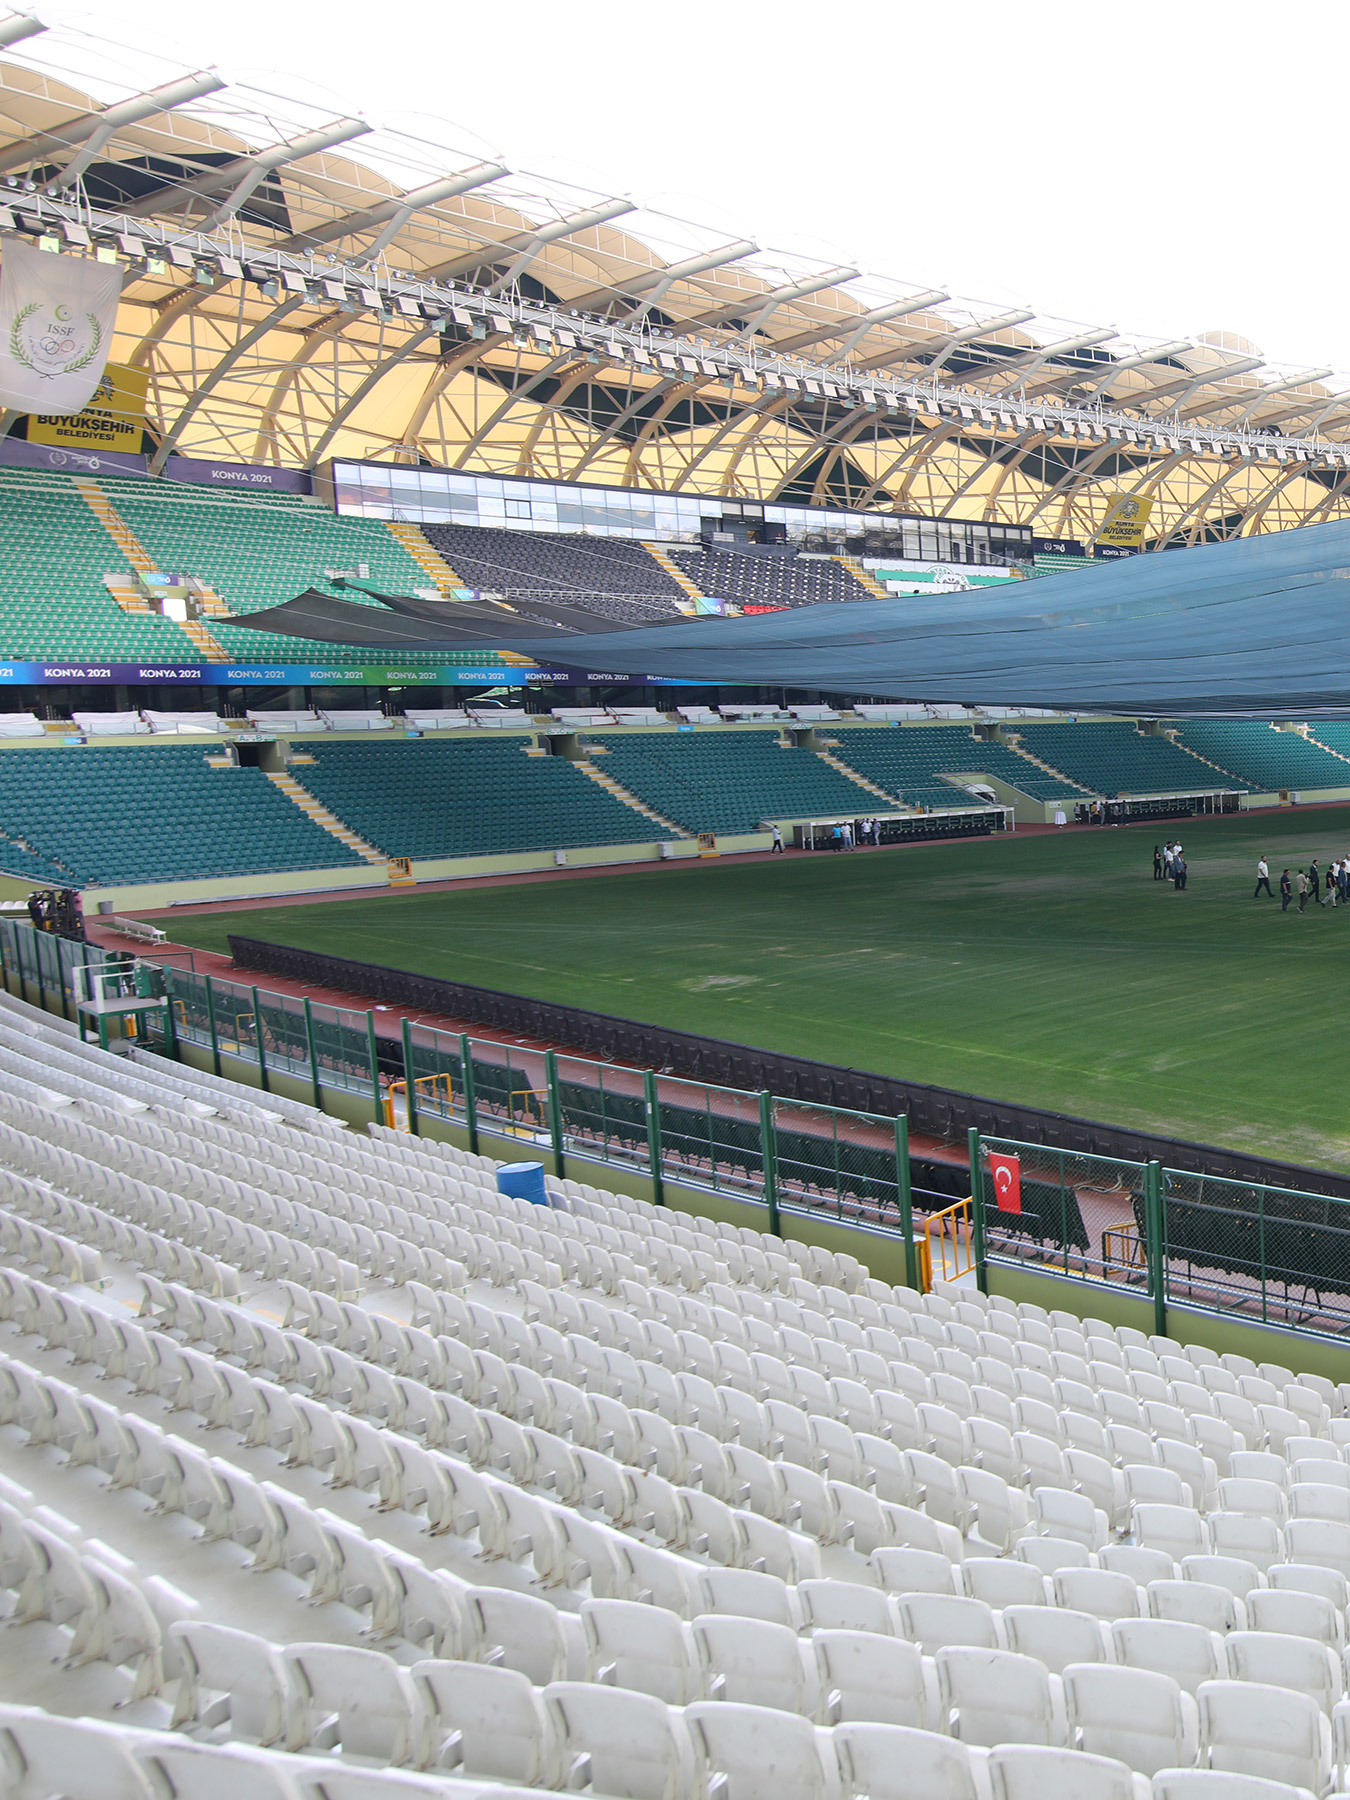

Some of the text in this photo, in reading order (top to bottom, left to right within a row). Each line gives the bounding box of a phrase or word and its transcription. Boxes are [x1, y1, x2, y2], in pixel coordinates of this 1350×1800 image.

[47, 323, 75, 336] ISSF
[56, 428, 115, 441] BELEDİYESİ
[211, 470, 273, 484] KONYA 2021
[44, 668, 112, 678] KONYA 2021
[139, 669, 201, 678] KONYA 2021
[228, 670, 285, 679] KONYA 2021
[310, 671, 343, 679] KONYA
[387, 672, 437, 680] KONYA 2021
[458, 672, 487, 680] KONYA
[525, 673, 552, 681] KONYA
[587, 673, 613, 681] KONYA
